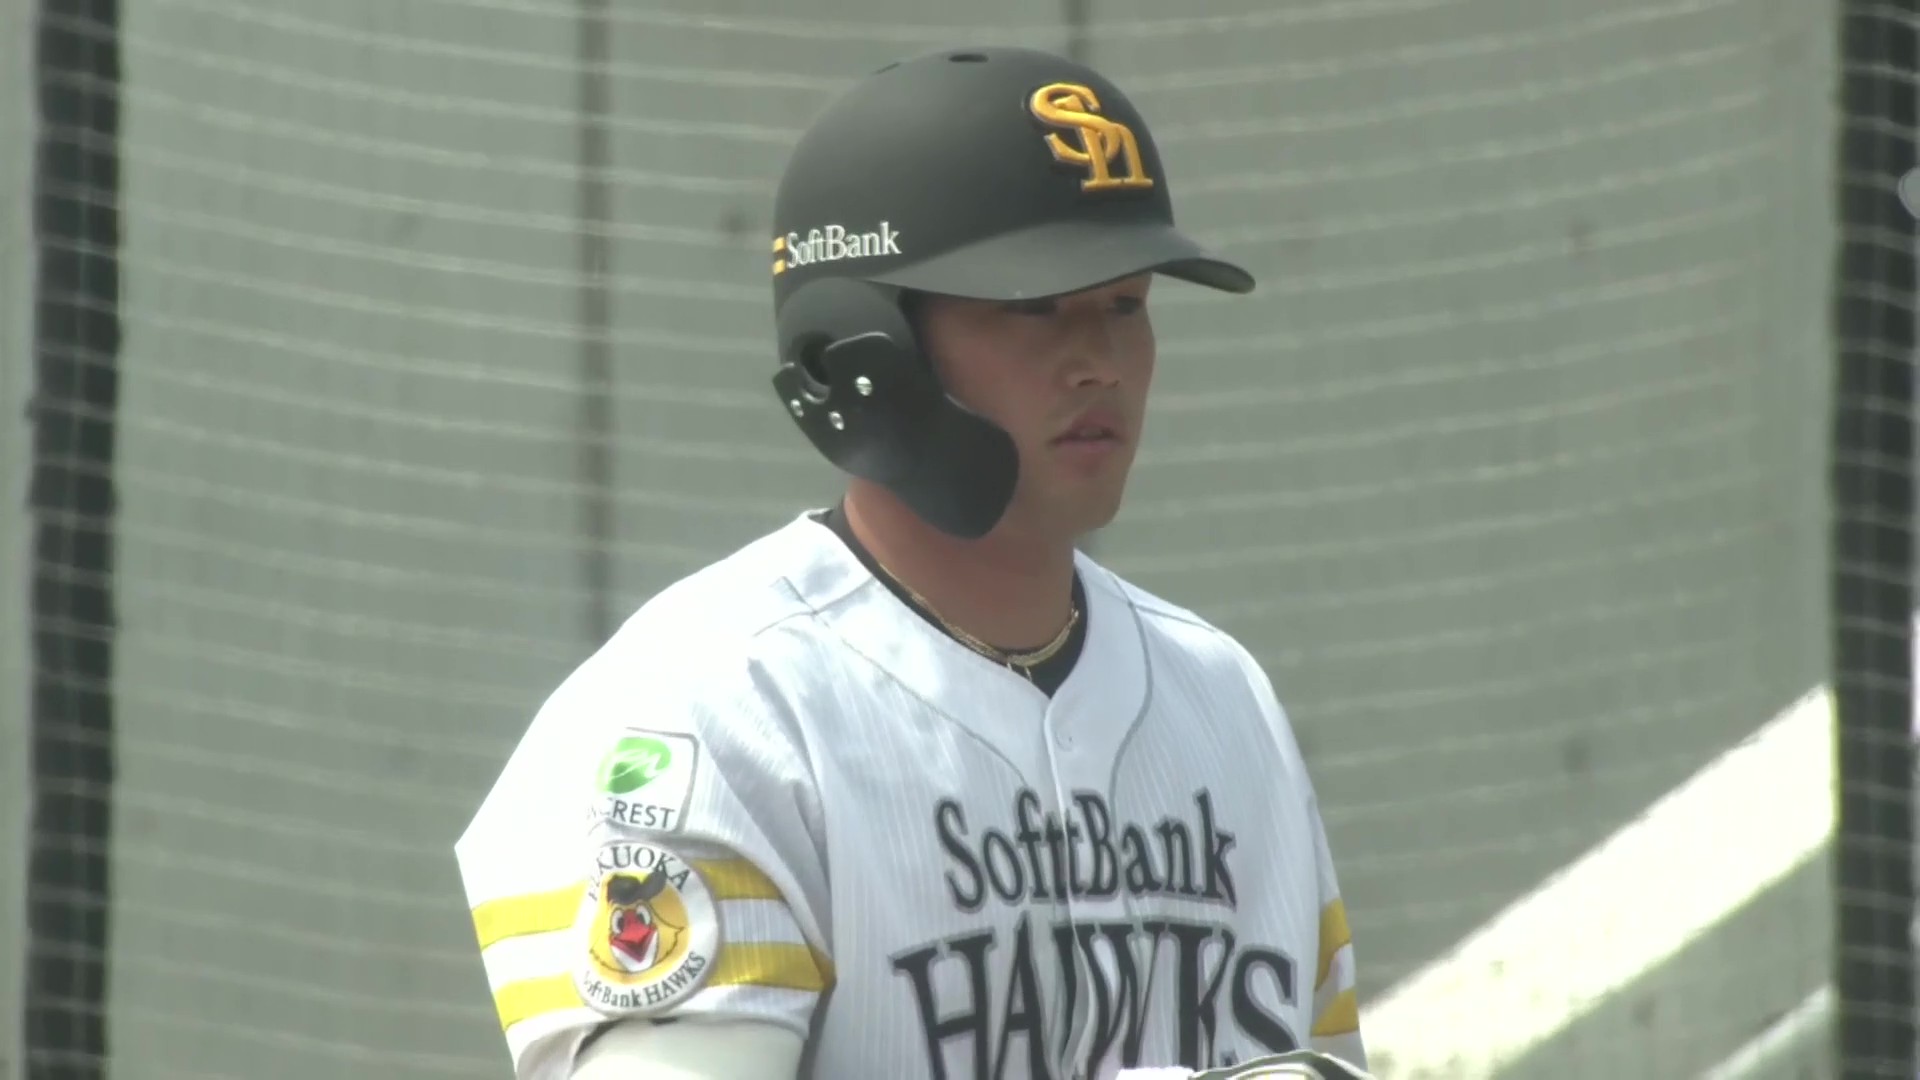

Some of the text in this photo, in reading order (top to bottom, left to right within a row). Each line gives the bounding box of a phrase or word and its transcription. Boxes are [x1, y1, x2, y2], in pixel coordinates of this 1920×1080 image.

[785, 221, 902, 269] SoftBank
[935, 787, 1238, 913] SoftBank
[642, 950, 706, 1005] HAWKS
[889, 908, 1298, 1080] HAWKS
